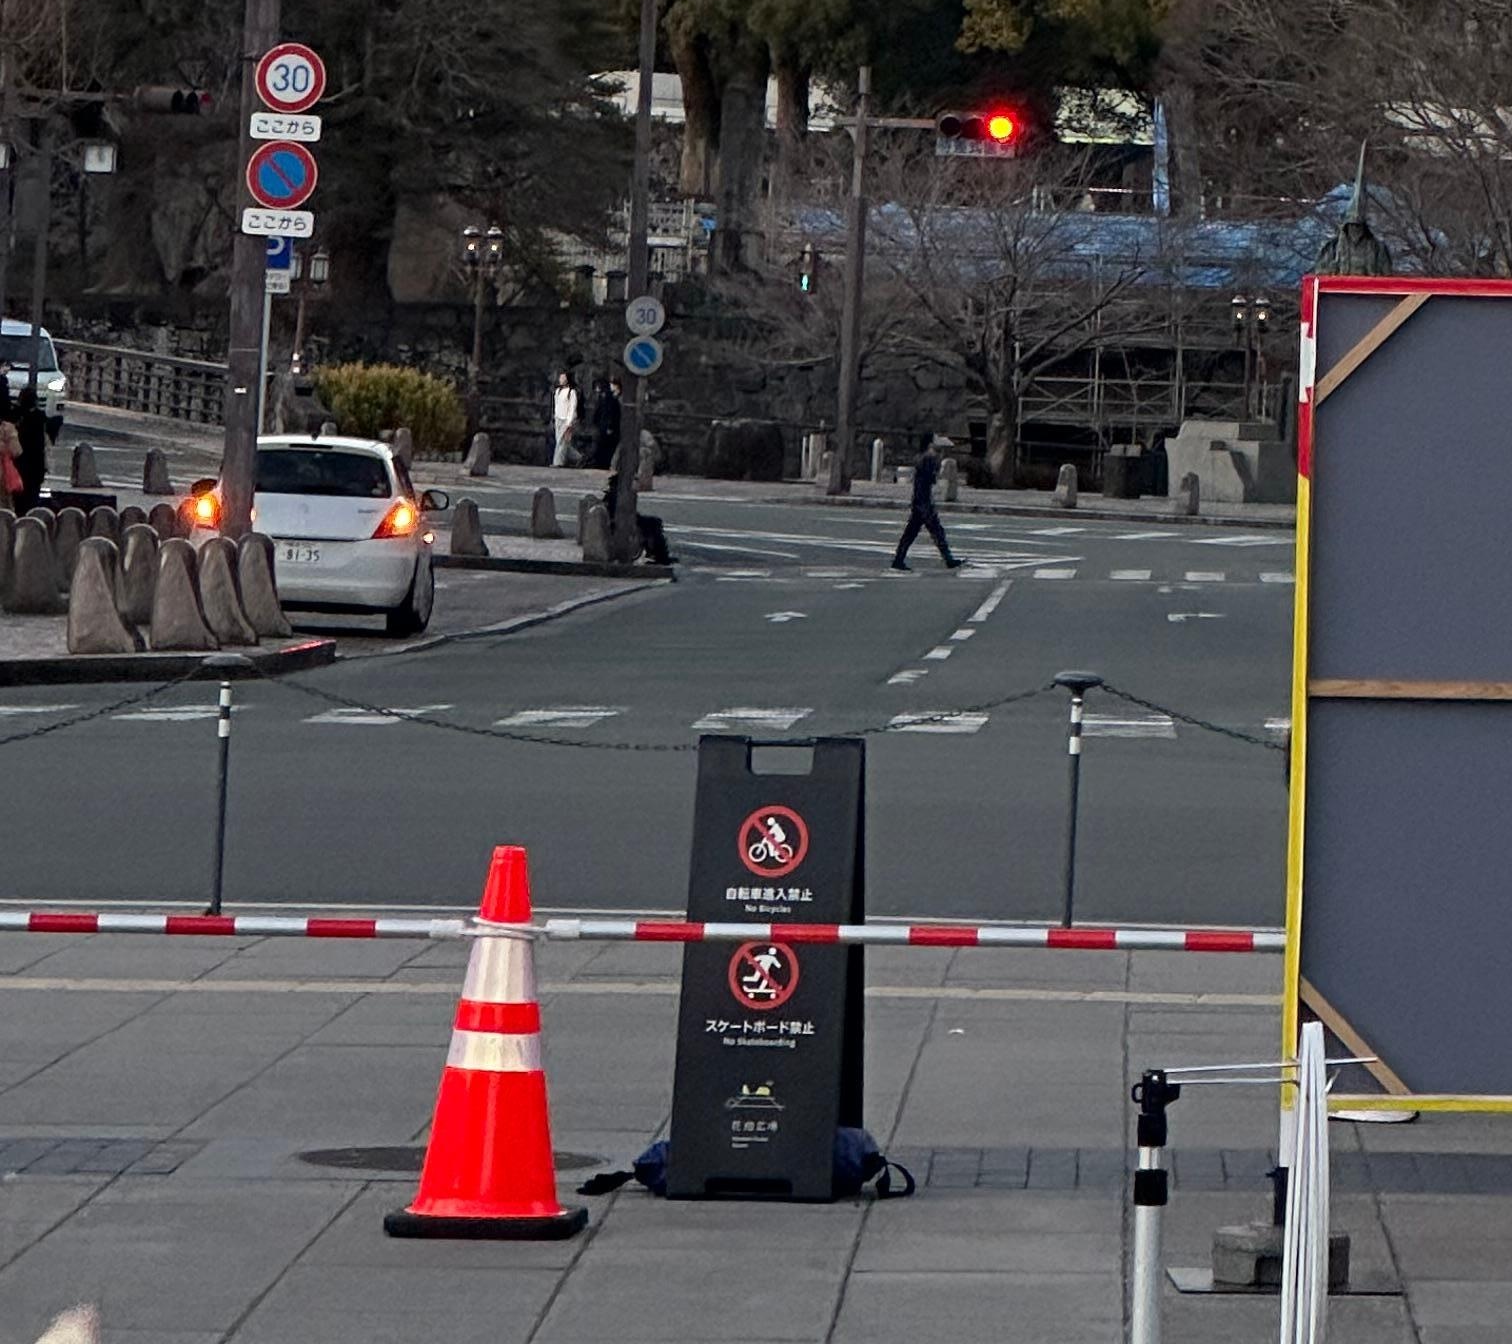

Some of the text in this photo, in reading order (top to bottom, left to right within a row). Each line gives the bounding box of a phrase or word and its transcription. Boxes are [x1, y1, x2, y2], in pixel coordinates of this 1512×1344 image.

[273, 64, 310, 93] 30
[256, 119, 315, 135] ここから
[248, 215, 307, 231] ここから
[635, 308, 657, 325] 30
[726, 887, 813, 901] 自転車進入禁止
[744, 904, 758, 912] No
[705, 1019, 815, 1034] スケートボード禁止
